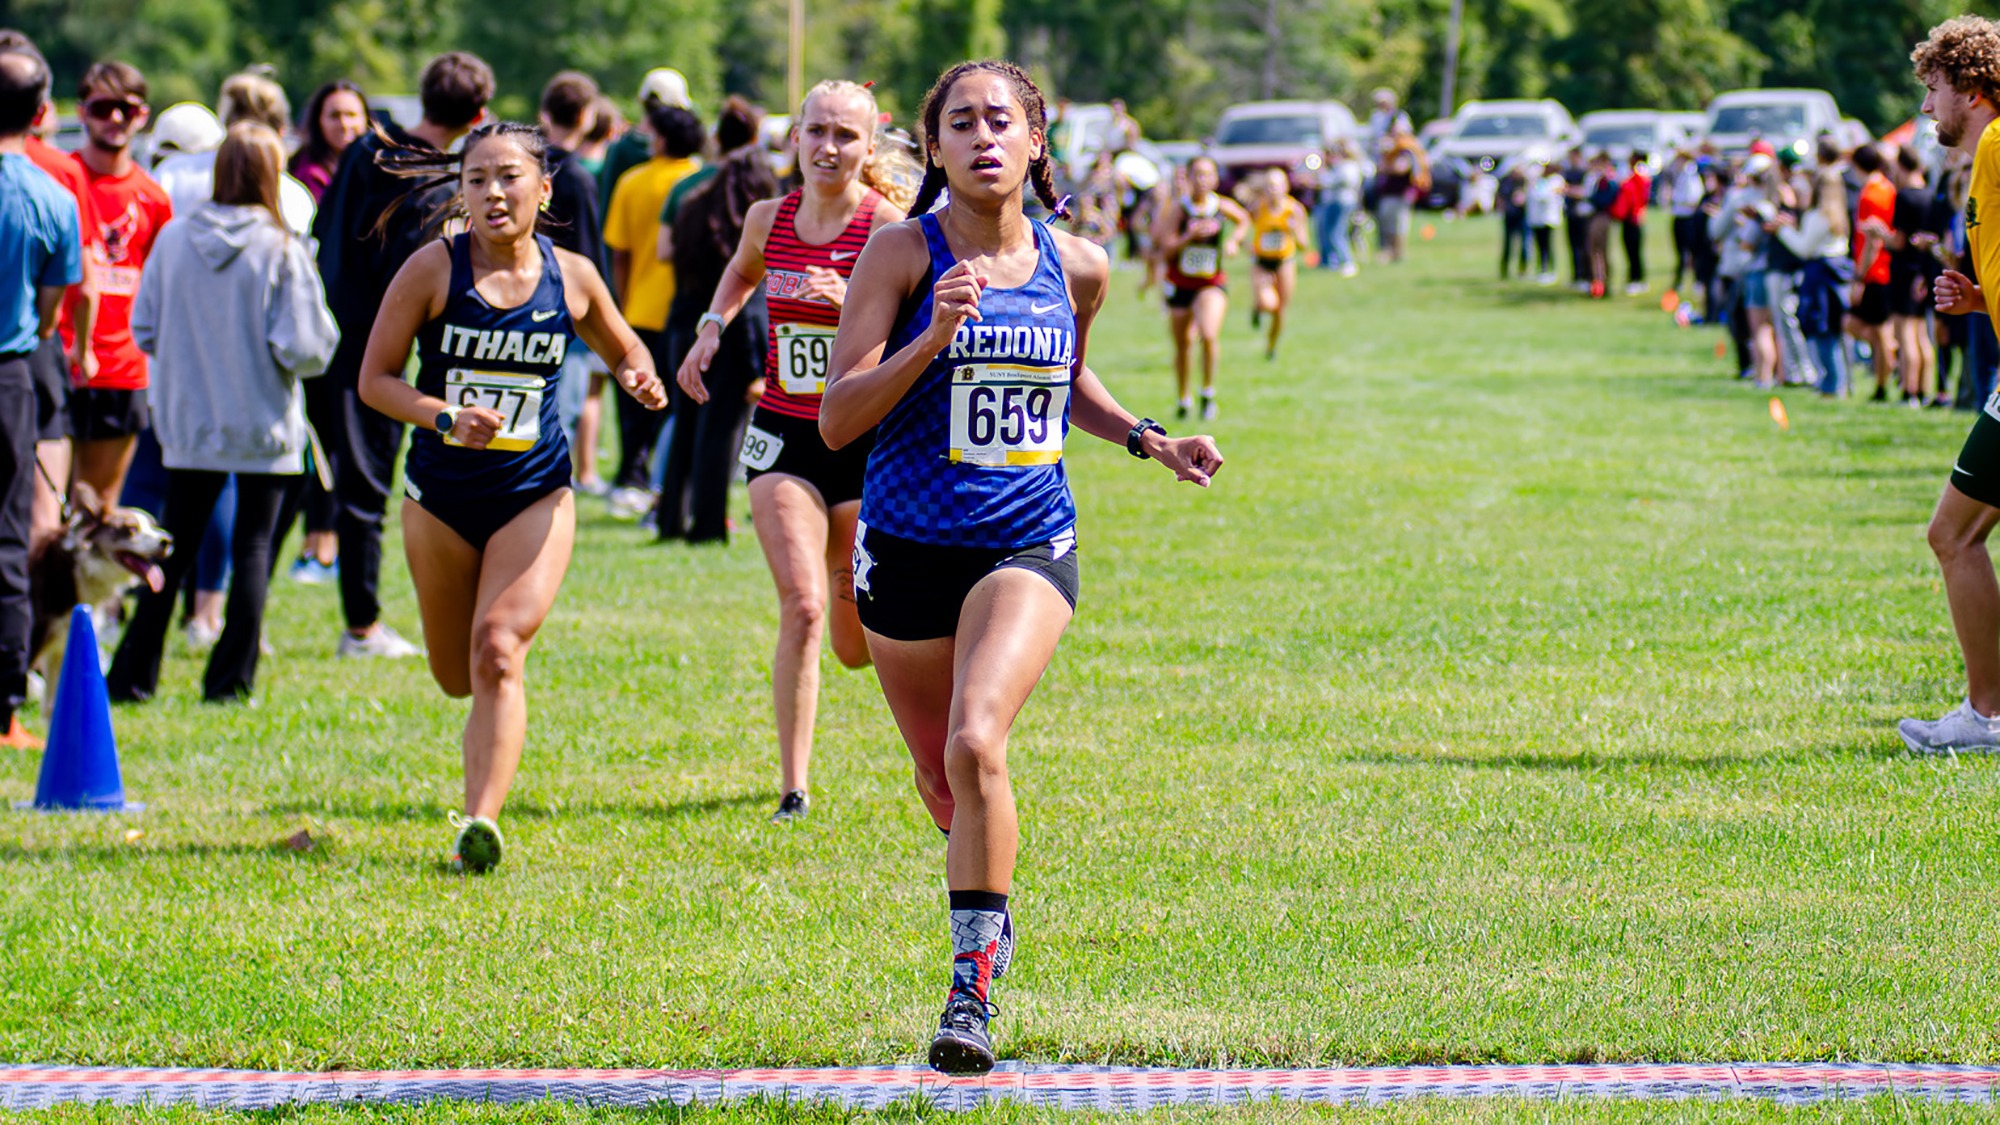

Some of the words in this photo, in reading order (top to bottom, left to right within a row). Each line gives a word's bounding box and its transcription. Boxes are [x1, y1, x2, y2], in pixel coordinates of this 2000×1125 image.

[440, 324, 566, 365] ITHACA
[789, 338, 835, 378] 69
[934, 326, 1073, 364] REDONIA
[968, 386, 1053, 446] 659
[743, 434, 768, 461] 99
